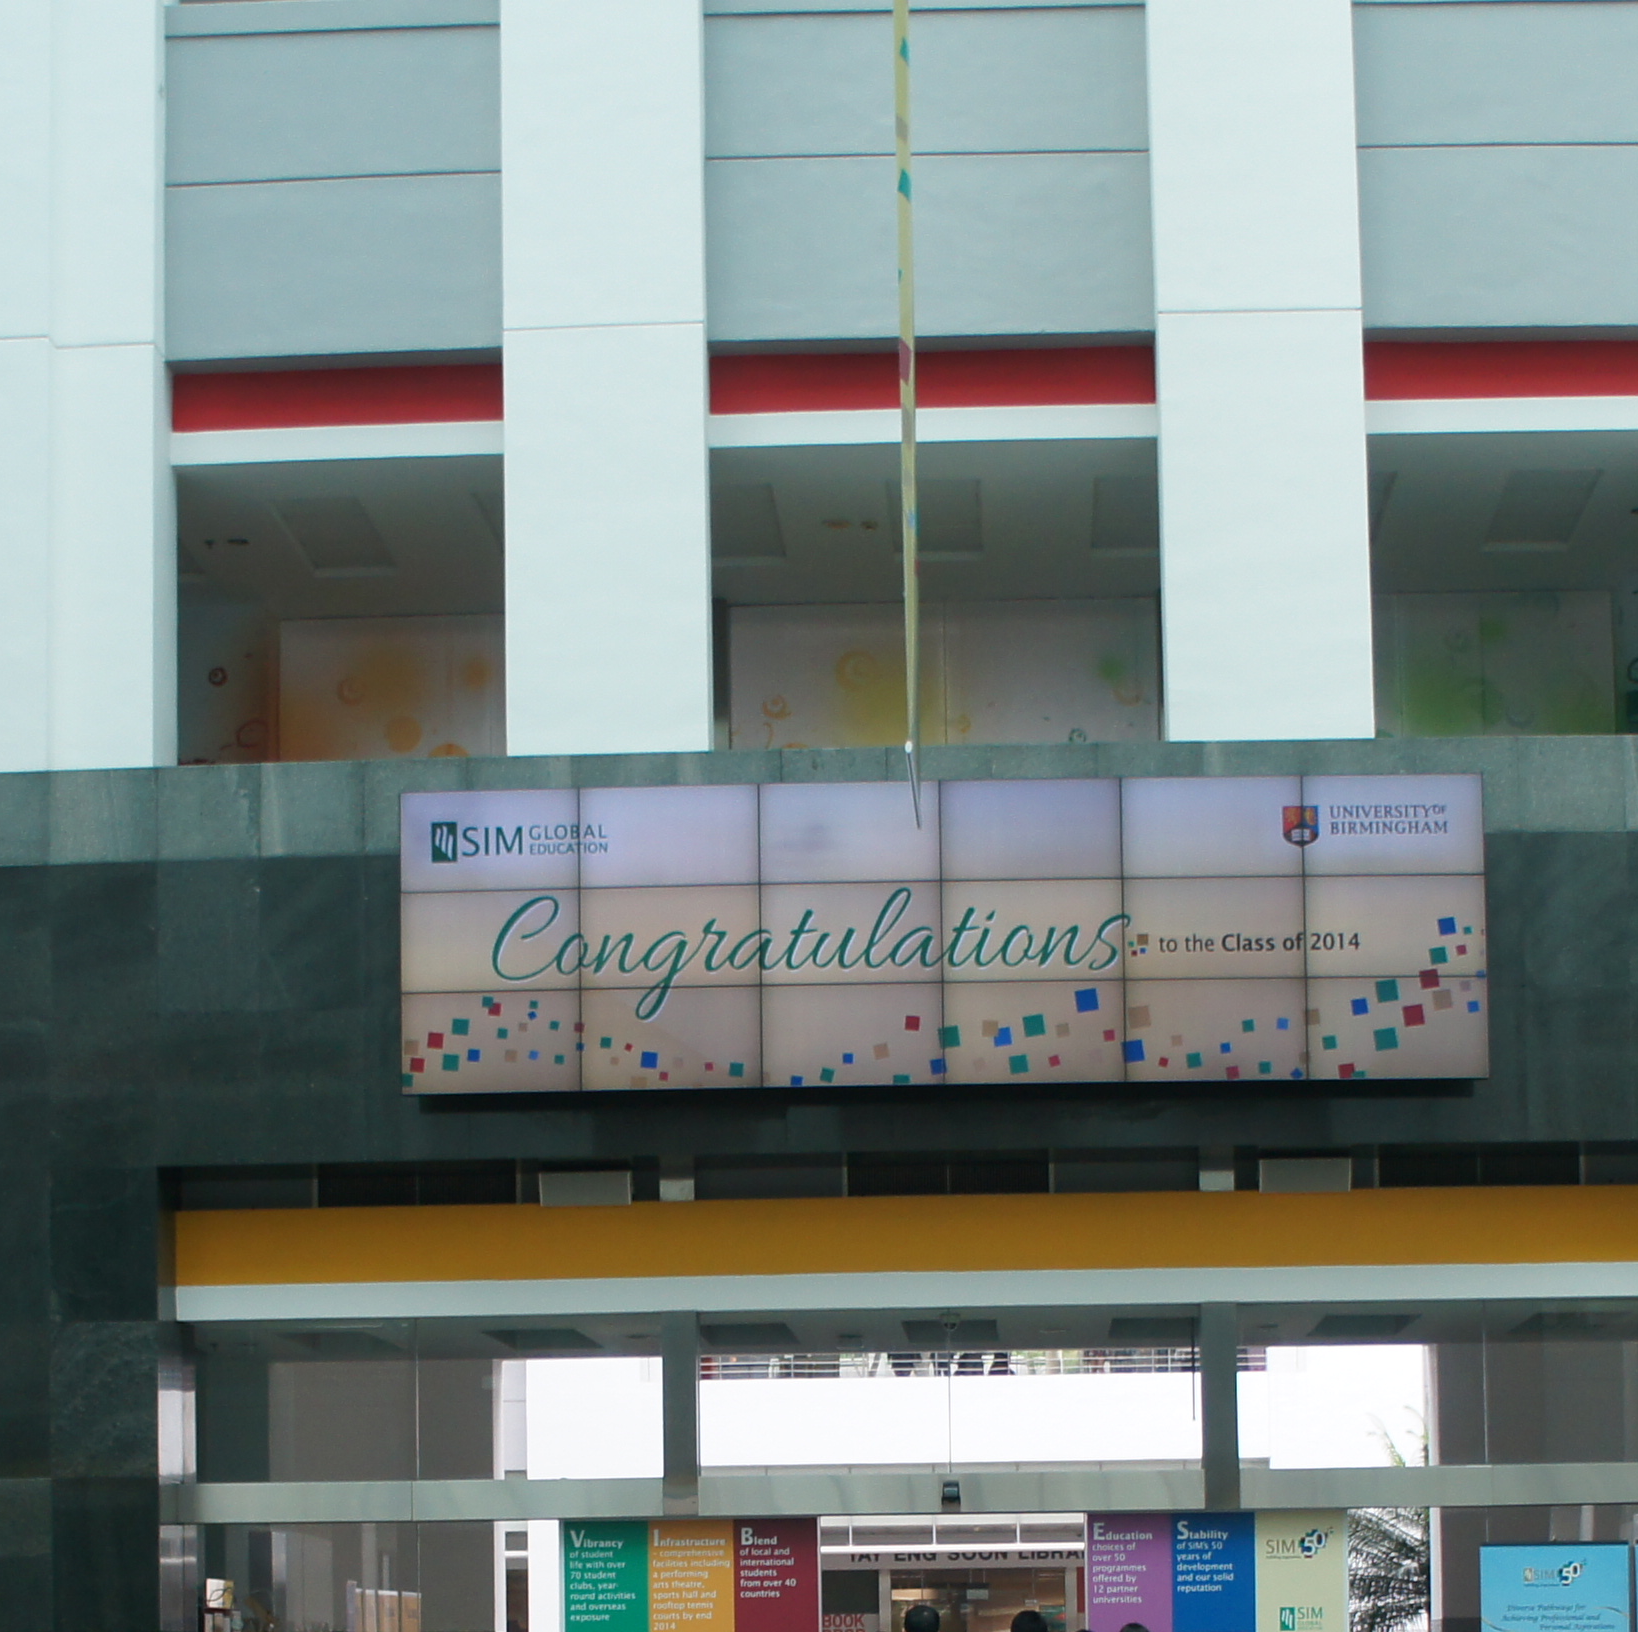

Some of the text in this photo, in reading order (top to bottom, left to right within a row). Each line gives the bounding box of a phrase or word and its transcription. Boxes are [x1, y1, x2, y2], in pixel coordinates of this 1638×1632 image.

[1329, 804, 1432, 819] UNIVERSITY
[529, 824, 608, 840] GLOBAL
[1330, 820, 1448, 835] BIRMINGHAM
[463, 826, 524, 857] SIM
[529, 842, 609, 856] EDUCATION
[1159, 932, 1360, 952] to the Class of 2014
[492, 887, 1131, 1021] Congratulations
[1093, 1522, 1153, 1540] Education
[1177, 1521, 1229, 1540] Stability
[570, 1529, 624, 1549] Vibrancy
[653, 1528, 726, 1546] Infrastructure
[741, 1527, 778, 1545] Blend
[1092, 1542, 1136, 1551] choices of
[1176, 1542, 1186, 1550] of
[1212, 1541, 1223, 1550] 50
[1266, 1531, 1326, 1556] SIM 50
[659, 1549, 724, 1558] comprehensive
[740, 1547, 790, 1556] of local and
[894, 1551, 936, 1562] ENG
[1018, 1550, 1084, 1560] LIBRA
[1114, 1553, 1125, 1561] 50
[1176, 1551, 1212, 1562] years of
[570, 1561, 583, 1569] life
[691, 1560, 730, 1568] including
[740, 1557, 794, 1566] international
[1093, 1565, 1146, 1573] programmes
[1177, 1562, 1233, 1572] development
[570, 1571, 616, 1579] 70 student
[661, 1570, 708, 1579] performing
[740, 1568, 777, 1577] students
[1177, 1573, 1193, 1582] and
[1213, 1572, 1234, 1581] solid
[1534, 1562, 1581, 1584] SIM 50
[740, 1579, 761, 1587] from
[785, 1578, 797, 1587] 40
[1093, 1574, 1136, 1583] offered by
[1094, 1585, 1138, 1594] 12 partner
[1177, 1584, 1222, 1594] reputation
[653, 1592, 679, 1600] sports
[740, 1590, 780, 1598] countries
[1093, 1595, 1142, 1604] universities
[570, 1602, 586, 1610] and
[653, 1601, 685, 1610] rooftop
[683, 1612, 693, 1620] by
[1298, 1607, 1323, 1619] SIM
[570, 1614, 610, 1622] exposure
[824, 1614, 865, 1628] BOOK
[653, 1622, 676, 1630] 2014
